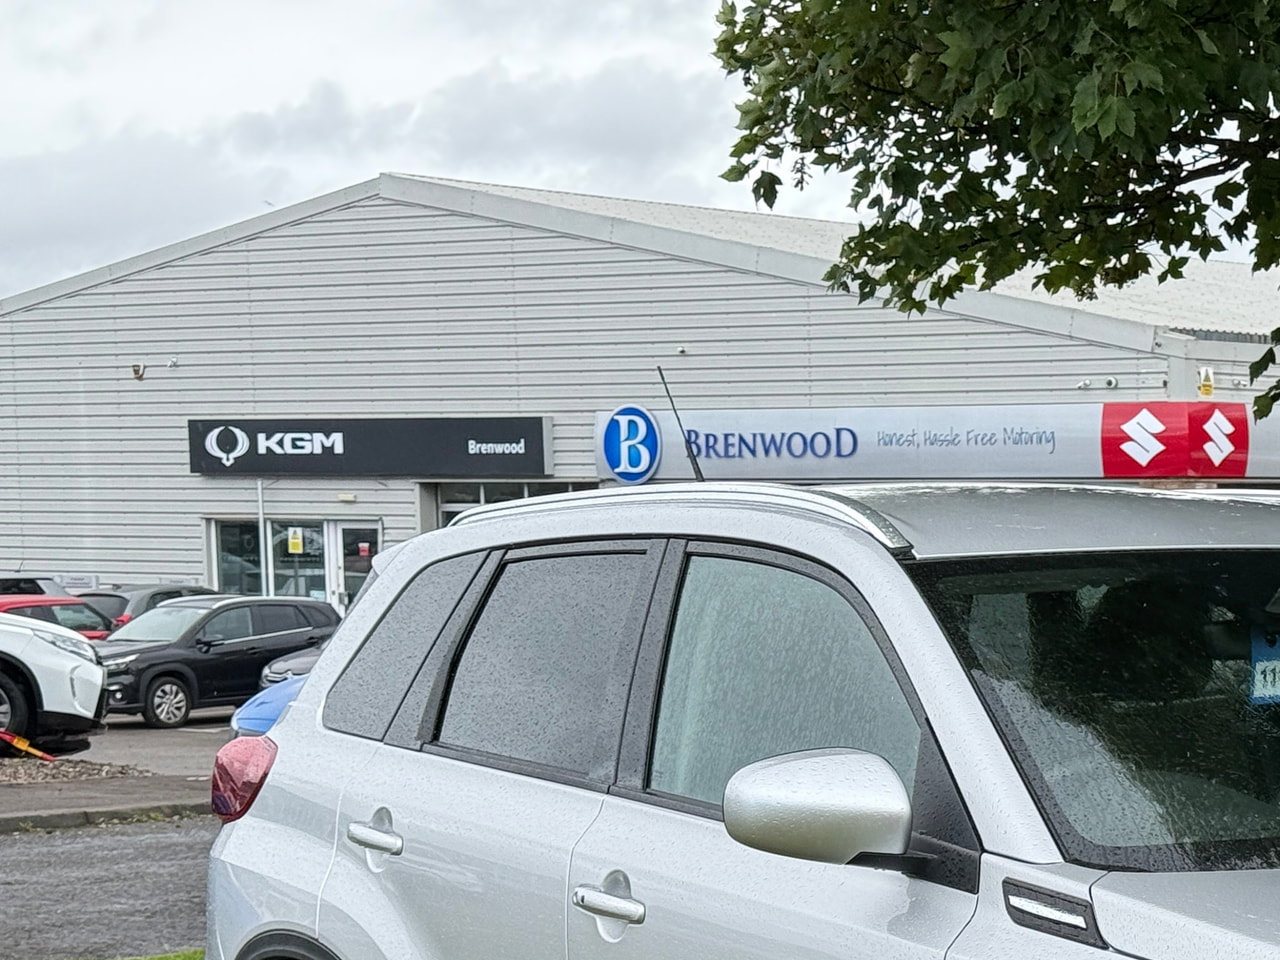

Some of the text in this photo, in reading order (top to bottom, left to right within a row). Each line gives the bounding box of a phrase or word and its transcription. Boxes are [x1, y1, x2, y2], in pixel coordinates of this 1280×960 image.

[256, 432, 345, 455] KGM
[467, 438, 526, 455] Brenwood
[685, 427, 859, 459] BRENWOOD
[877, 426, 1056, 454] Honest, Hassle Free Motoring
